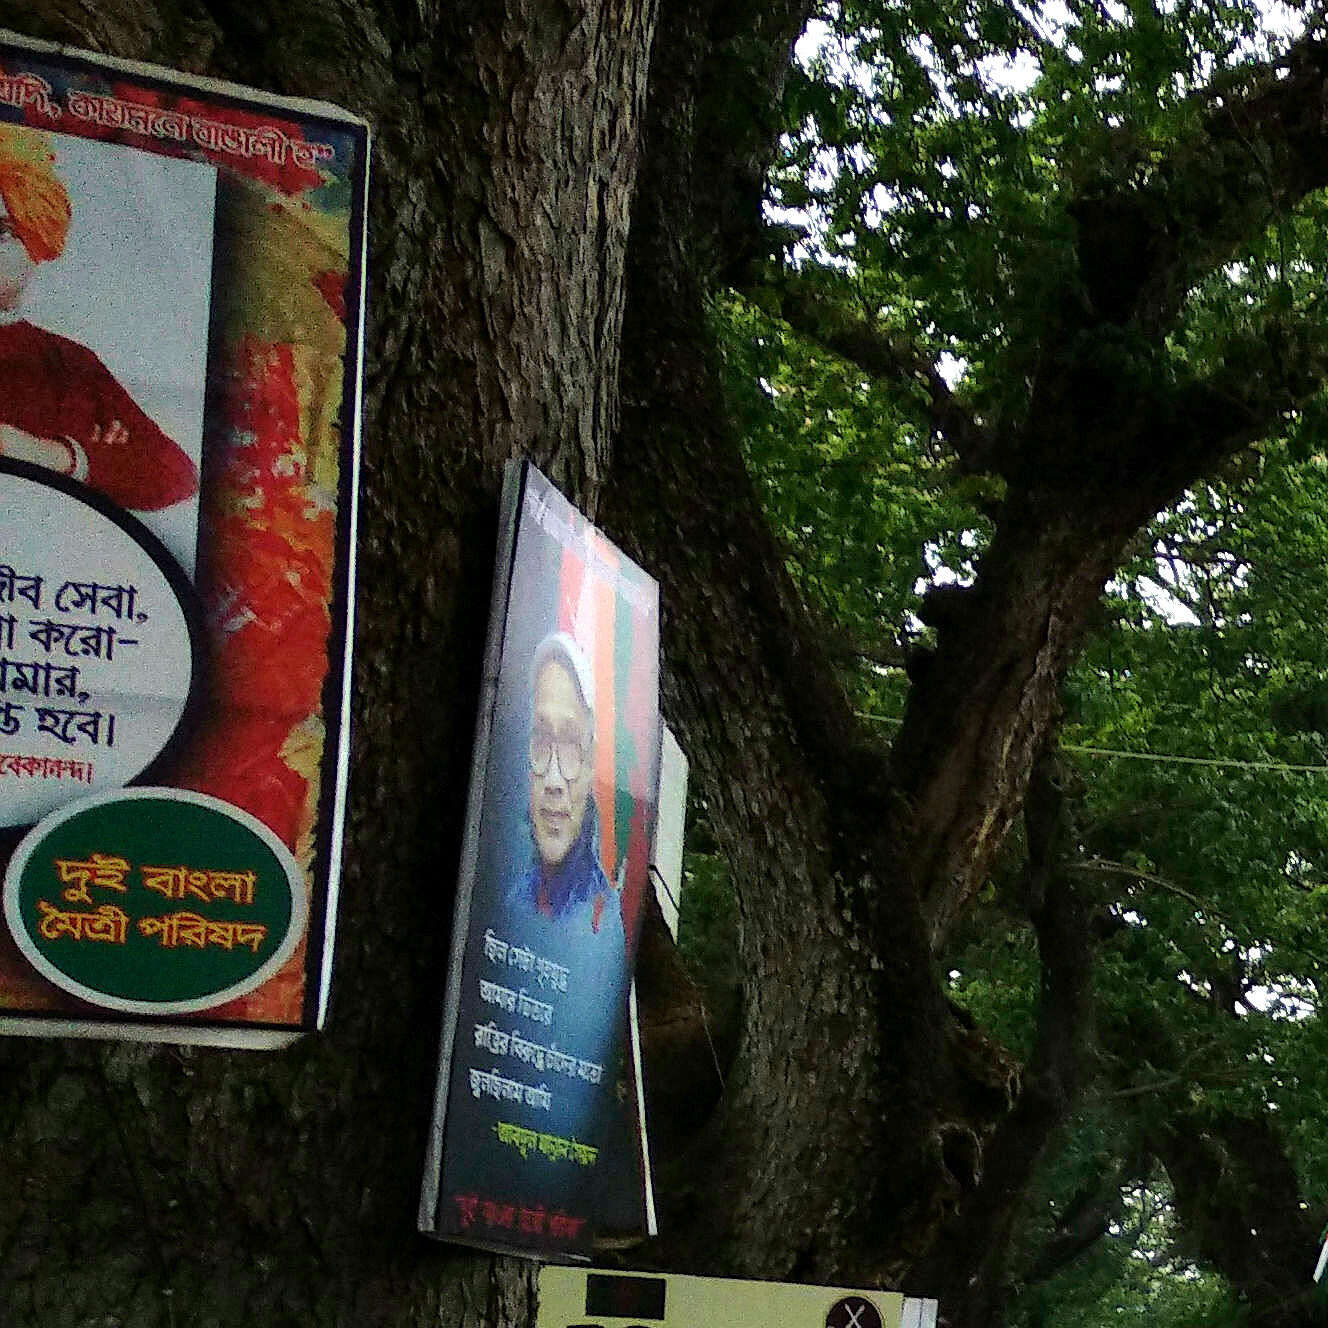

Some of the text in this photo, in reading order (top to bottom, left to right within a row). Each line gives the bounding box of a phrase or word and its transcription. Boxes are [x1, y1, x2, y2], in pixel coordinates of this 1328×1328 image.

[55, 581, 149, 625] সেবা,
[35, 706, 116, 747] হবে।
[54, 852, 258, 905] দুই বাংলা
[37, 899, 269, 953] মৈত্রী পরিষদ
